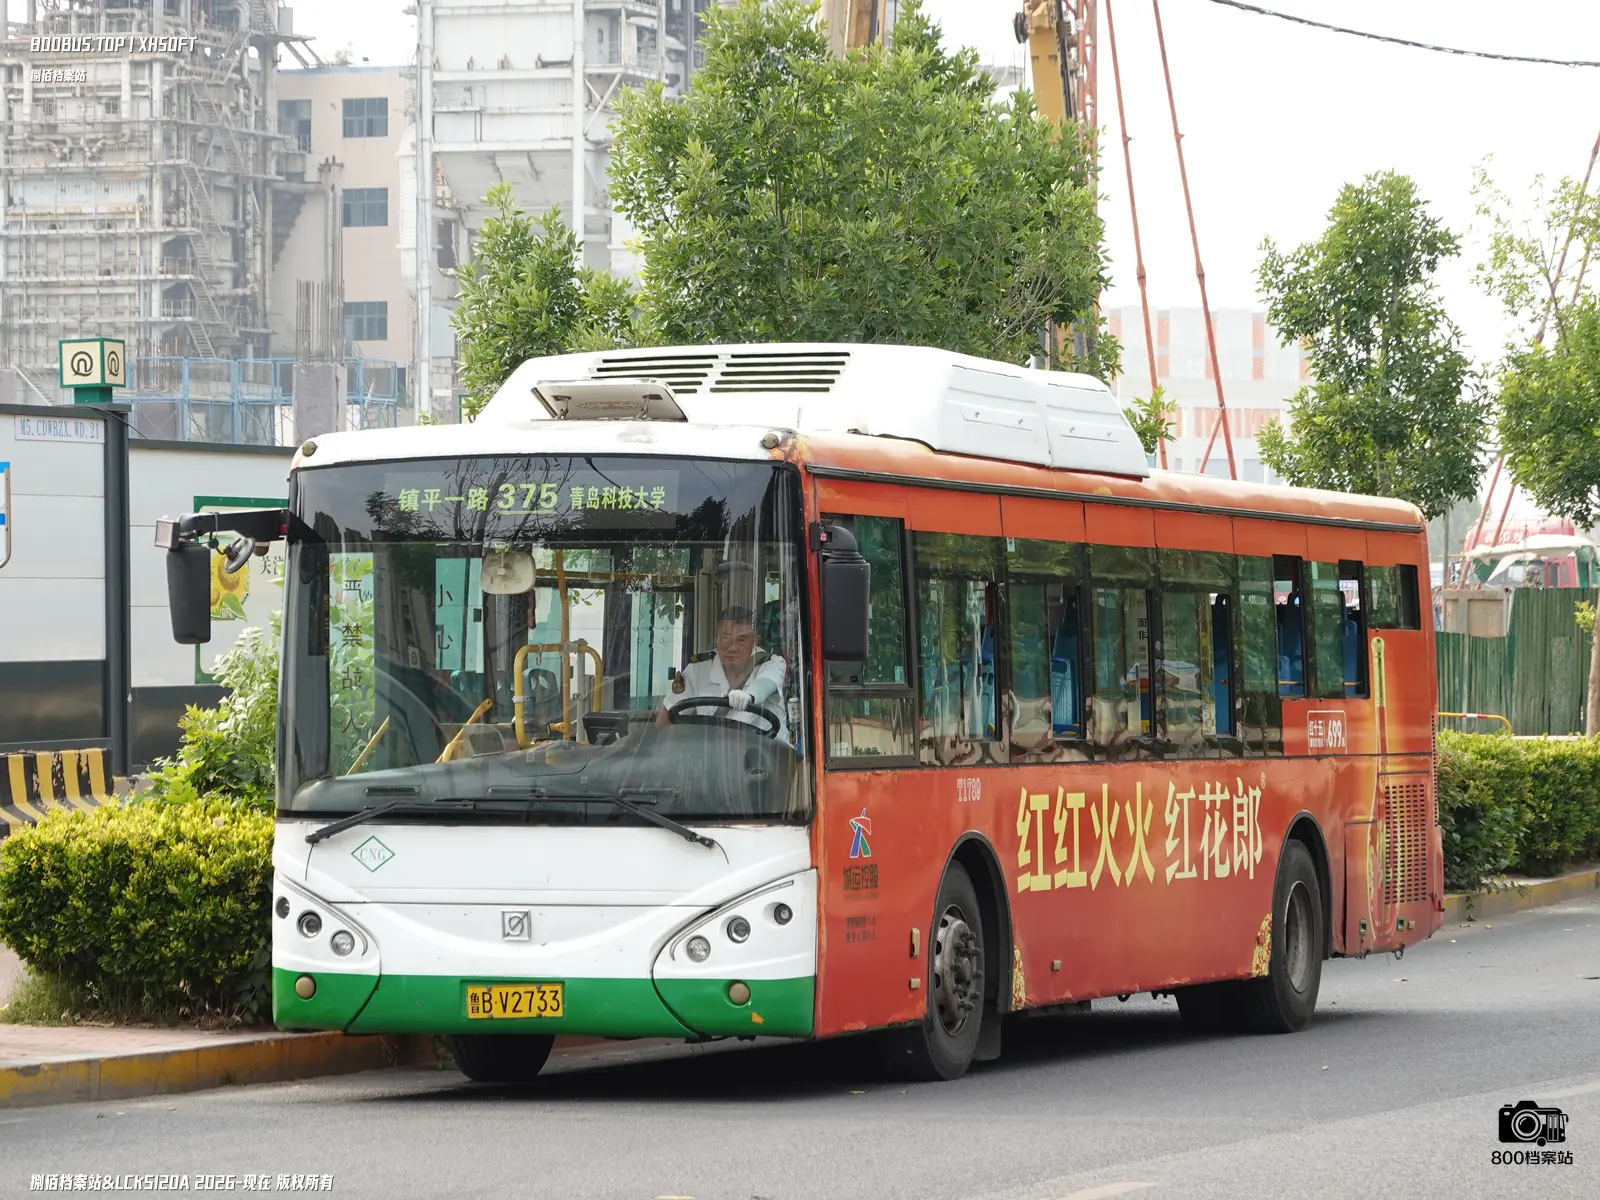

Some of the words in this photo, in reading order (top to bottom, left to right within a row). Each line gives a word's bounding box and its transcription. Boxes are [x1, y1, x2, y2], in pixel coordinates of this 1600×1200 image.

[398, 487, 489, 512] 镇平一路
[497, 483, 558, 510] 375
[569, 486, 666, 511] 青岛科技大学
[1016, 781, 1155, 893] 红红火火
[1164, 776, 1263, 887] 红花郎
[359, 848, 386, 862] CNG
[843, 864, 879, 891] 城运控股
